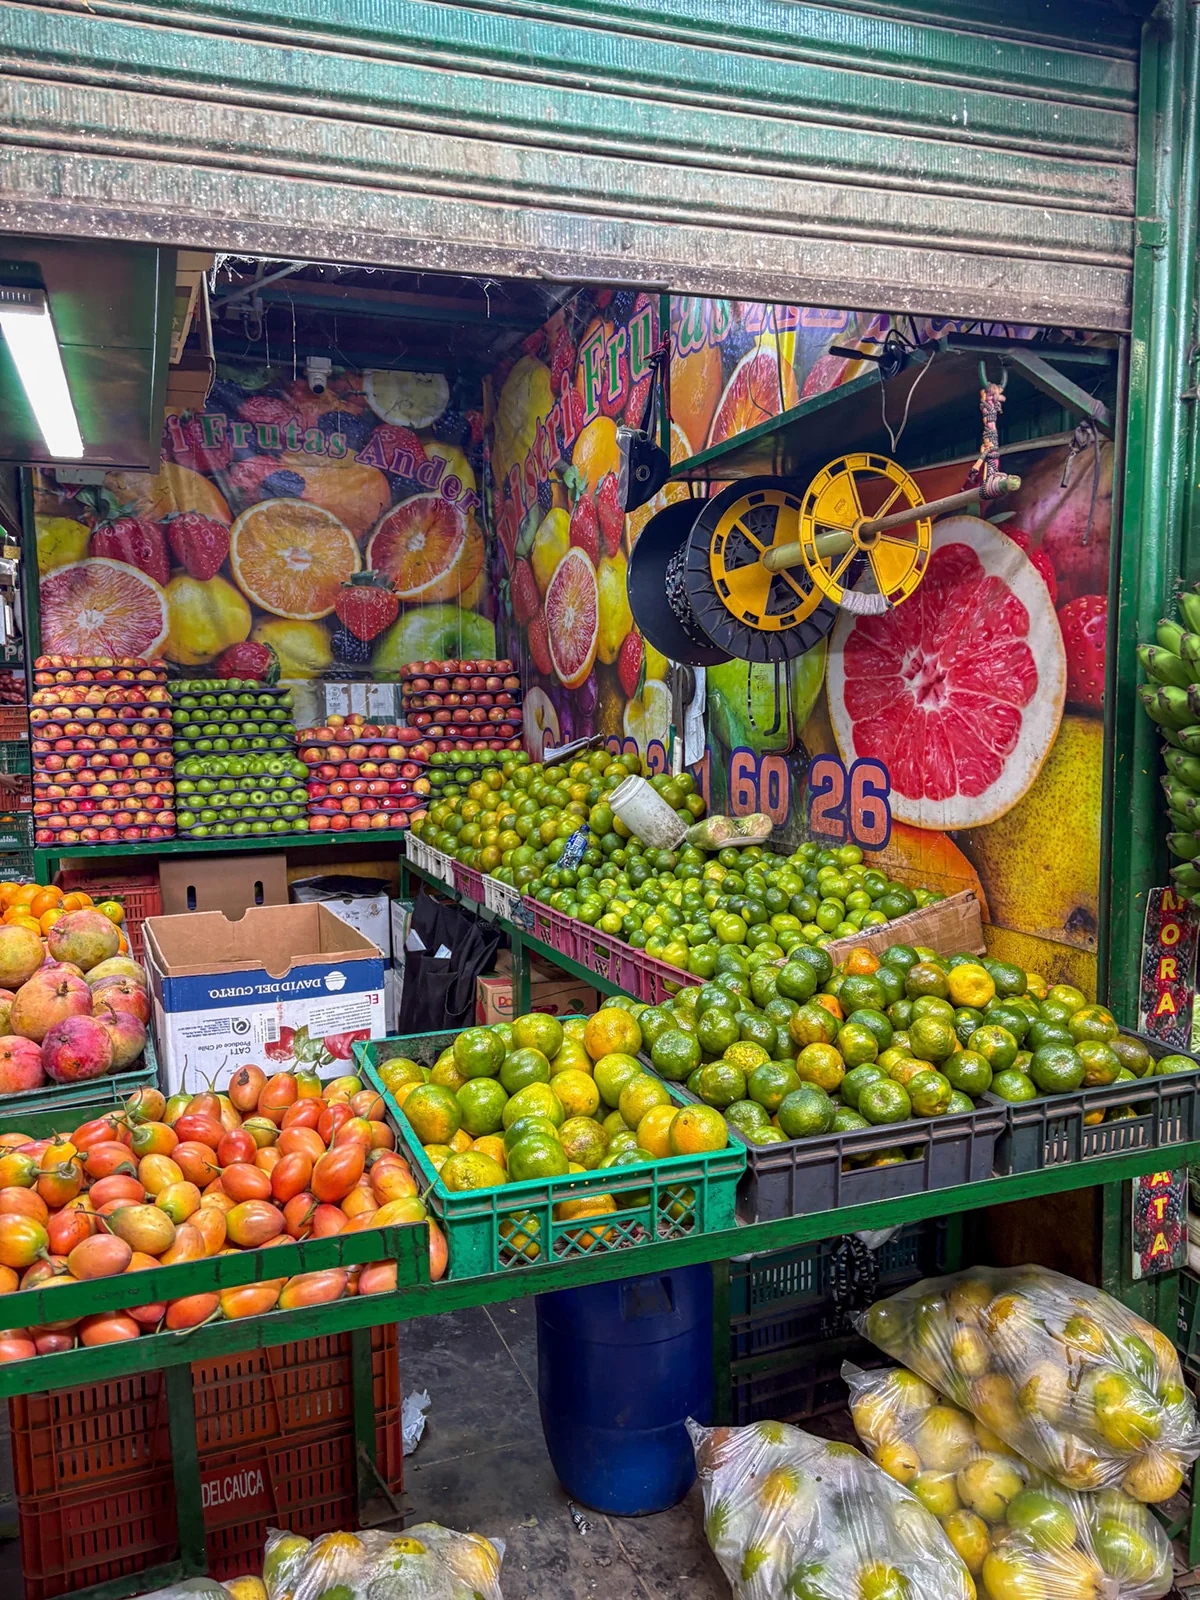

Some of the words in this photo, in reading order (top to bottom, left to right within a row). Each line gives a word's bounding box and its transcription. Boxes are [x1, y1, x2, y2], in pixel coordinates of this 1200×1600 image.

[196, 412, 348, 459] Frutas
[353, 428, 482, 515] Ander
[727, 746, 790, 830] 60
[808, 753, 892, 851] 26
[255, 984, 281, 994] DEL
[281, 978, 321, 992] DAVID
